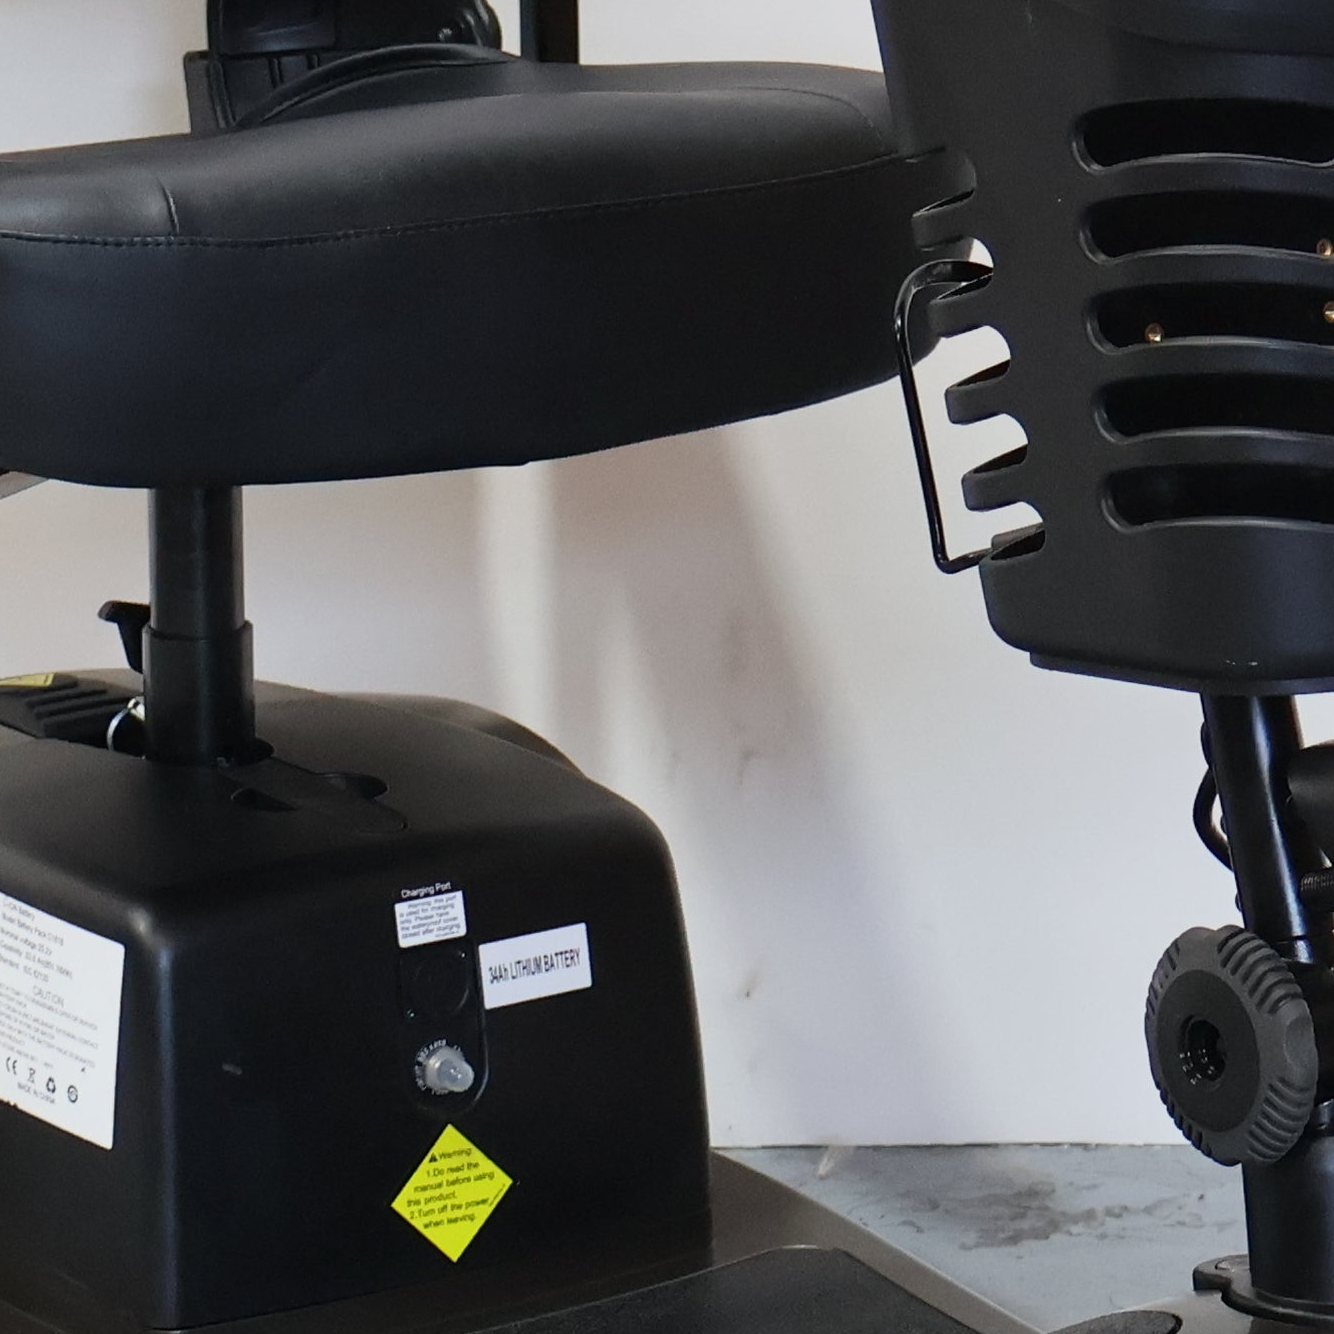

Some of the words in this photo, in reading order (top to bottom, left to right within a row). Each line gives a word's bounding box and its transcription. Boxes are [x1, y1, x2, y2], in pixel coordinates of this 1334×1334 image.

[401, 886, 435, 898] Charging
[435, 882, 452, 891] Port
[430, 903, 455, 912] charging
[412, 918, 442, 929] waterproof
[488, 963, 509, 984] 34Ah
[510, 955, 544, 980] LITHIUM
[543, 948, 582, 973] BATTERY
[33, 986, 65, 1007] CAUTION
[446, 1163, 465, 1174] read
[466, 1161, 480, 1170] the
[414, 1181, 444, 1193] manual
[446, 1176, 472, 1187] before
[473, 1171, 495, 1182] using
[407, 1198, 422, 1208] this
[437, 1202, 448, 1214] off
[450, 1202, 464, 1212] the
[423, 1219, 445, 1230] when
